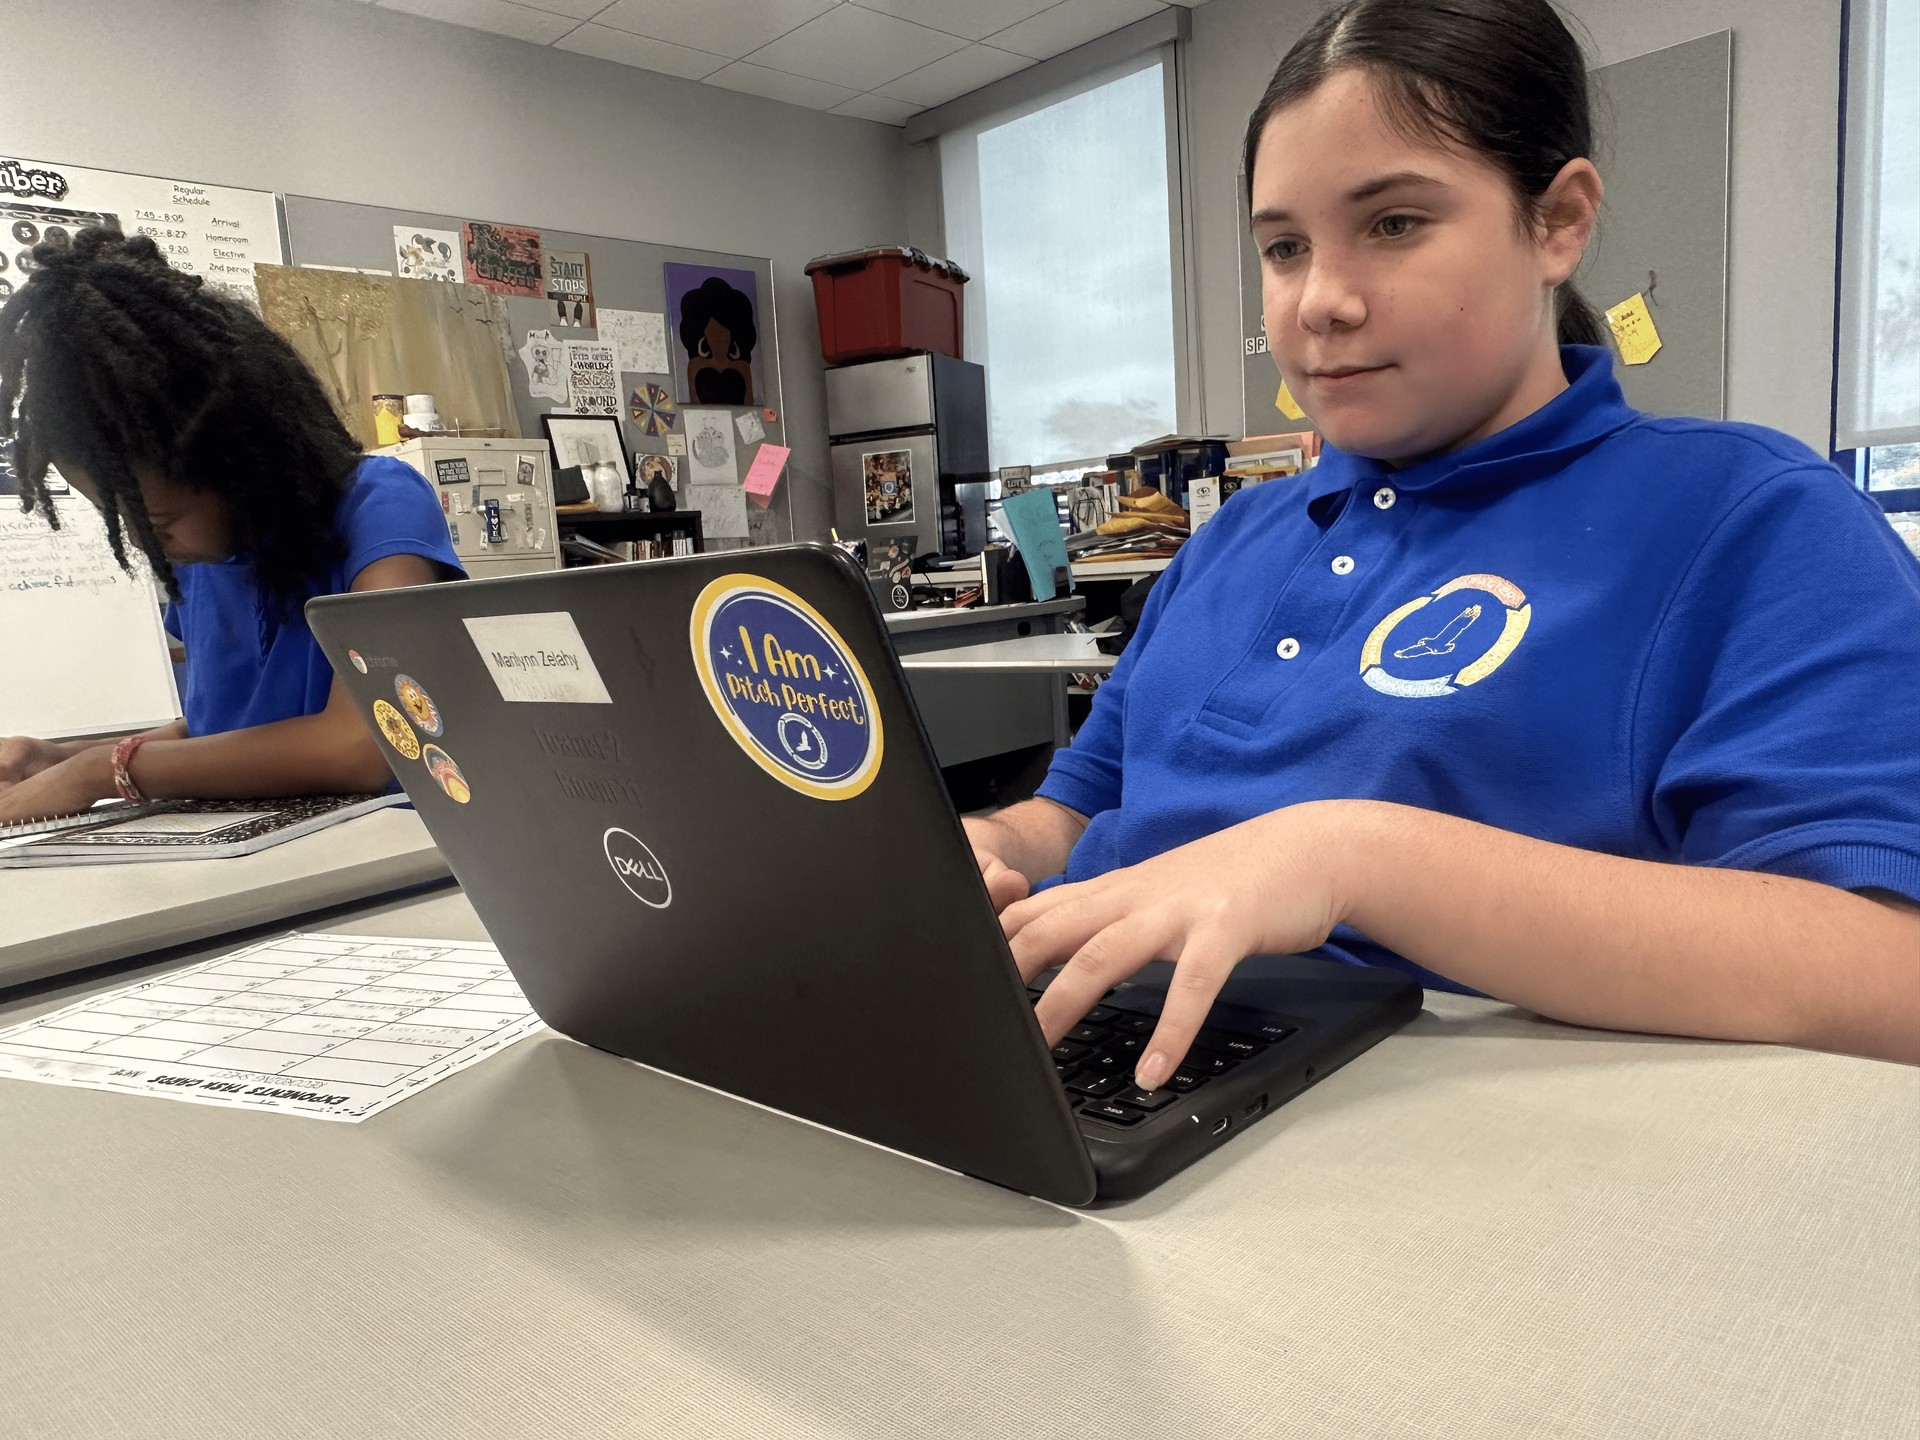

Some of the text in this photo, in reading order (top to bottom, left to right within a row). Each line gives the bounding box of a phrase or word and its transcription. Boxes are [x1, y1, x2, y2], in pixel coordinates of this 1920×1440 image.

[173, 185, 206, 195] Regular
[172, 195, 210, 206] Schedule
[135, 210, 155, 218] 7:45
[164, 213, 184, 222] 8:05
[211, 217, 240, 228] Arrival
[167, 229, 187, 239] 8:27
[205, 233, 249, 244] Homeroom
[168, 244, 189, 254] 9:20
[213, 249, 246, 259] Elective
[209, 263, 225, 272] 2nd
[551, 278, 586, 293] STOPS
[738, 625, 821, 681] I Am
[781, 682, 864, 726] Perfect
[614, 856, 664, 882] DELL
[147, 1075, 350, 1105] EXPONENTS TASK CARDS
